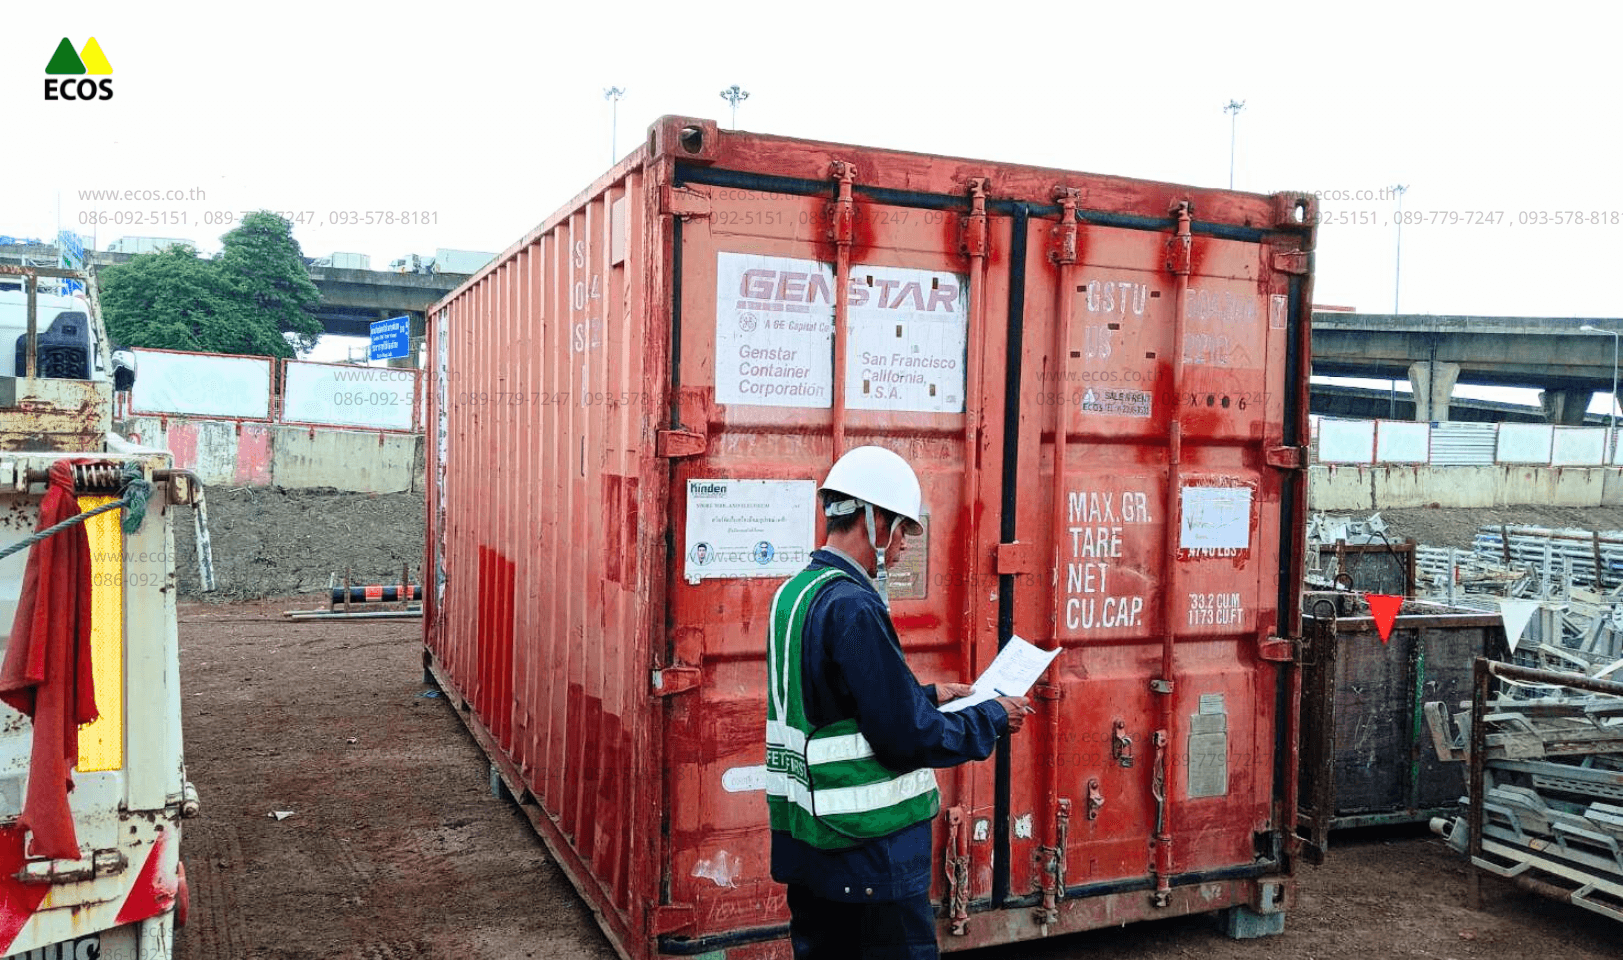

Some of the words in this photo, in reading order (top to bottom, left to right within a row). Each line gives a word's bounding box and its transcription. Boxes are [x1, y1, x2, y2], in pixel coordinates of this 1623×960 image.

[738, 267, 960, 314] GENSTAR
[1086, 279, 1147, 316] GSTU
[738, 344, 798, 362] Genstar
[861, 351, 888, 367] San
[890, 353, 957, 371] Francisco
[738, 362, 811, 379] Container
[738, 380, 824, 398] Corporation
[690, 482, 727, 494] Kinden
[1068, 526, 1124, 559] TARE
[1066, 562, 1110, 594] NET
[1187, 608, 1214, 625] 1173
